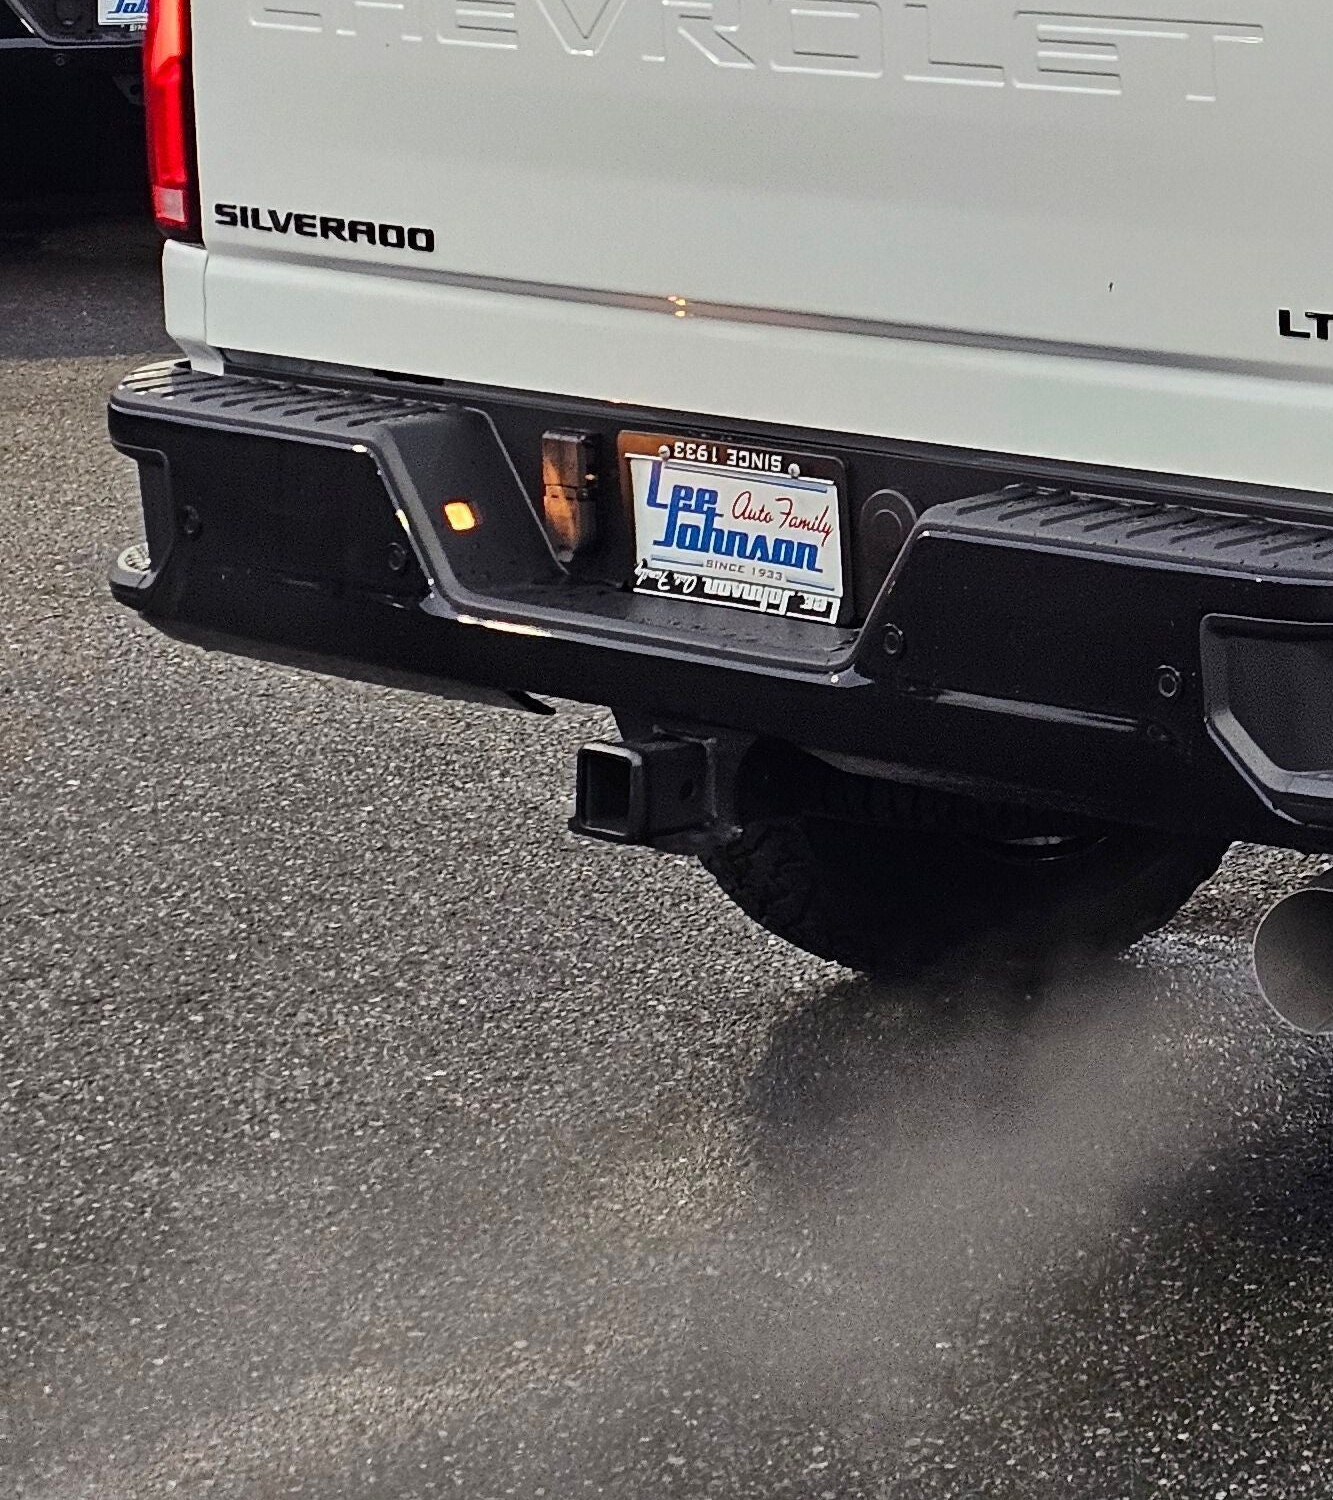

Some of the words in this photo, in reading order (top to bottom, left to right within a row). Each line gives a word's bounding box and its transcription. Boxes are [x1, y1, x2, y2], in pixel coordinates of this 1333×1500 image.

[214, 203, 435, 252] SILVERADO
[673, 441, 718, 463] 1933
[726, 448, 782, 472] SINCE
[646, 461, 724, 518] Lee
[653, 504, 823, 573] Johnson
[732, 490, 773, 524] Auto
[775, 497, 832, 547] Family
[706, 559, 745, 574] SINCE
[752, 567, 783, 581] 1933
